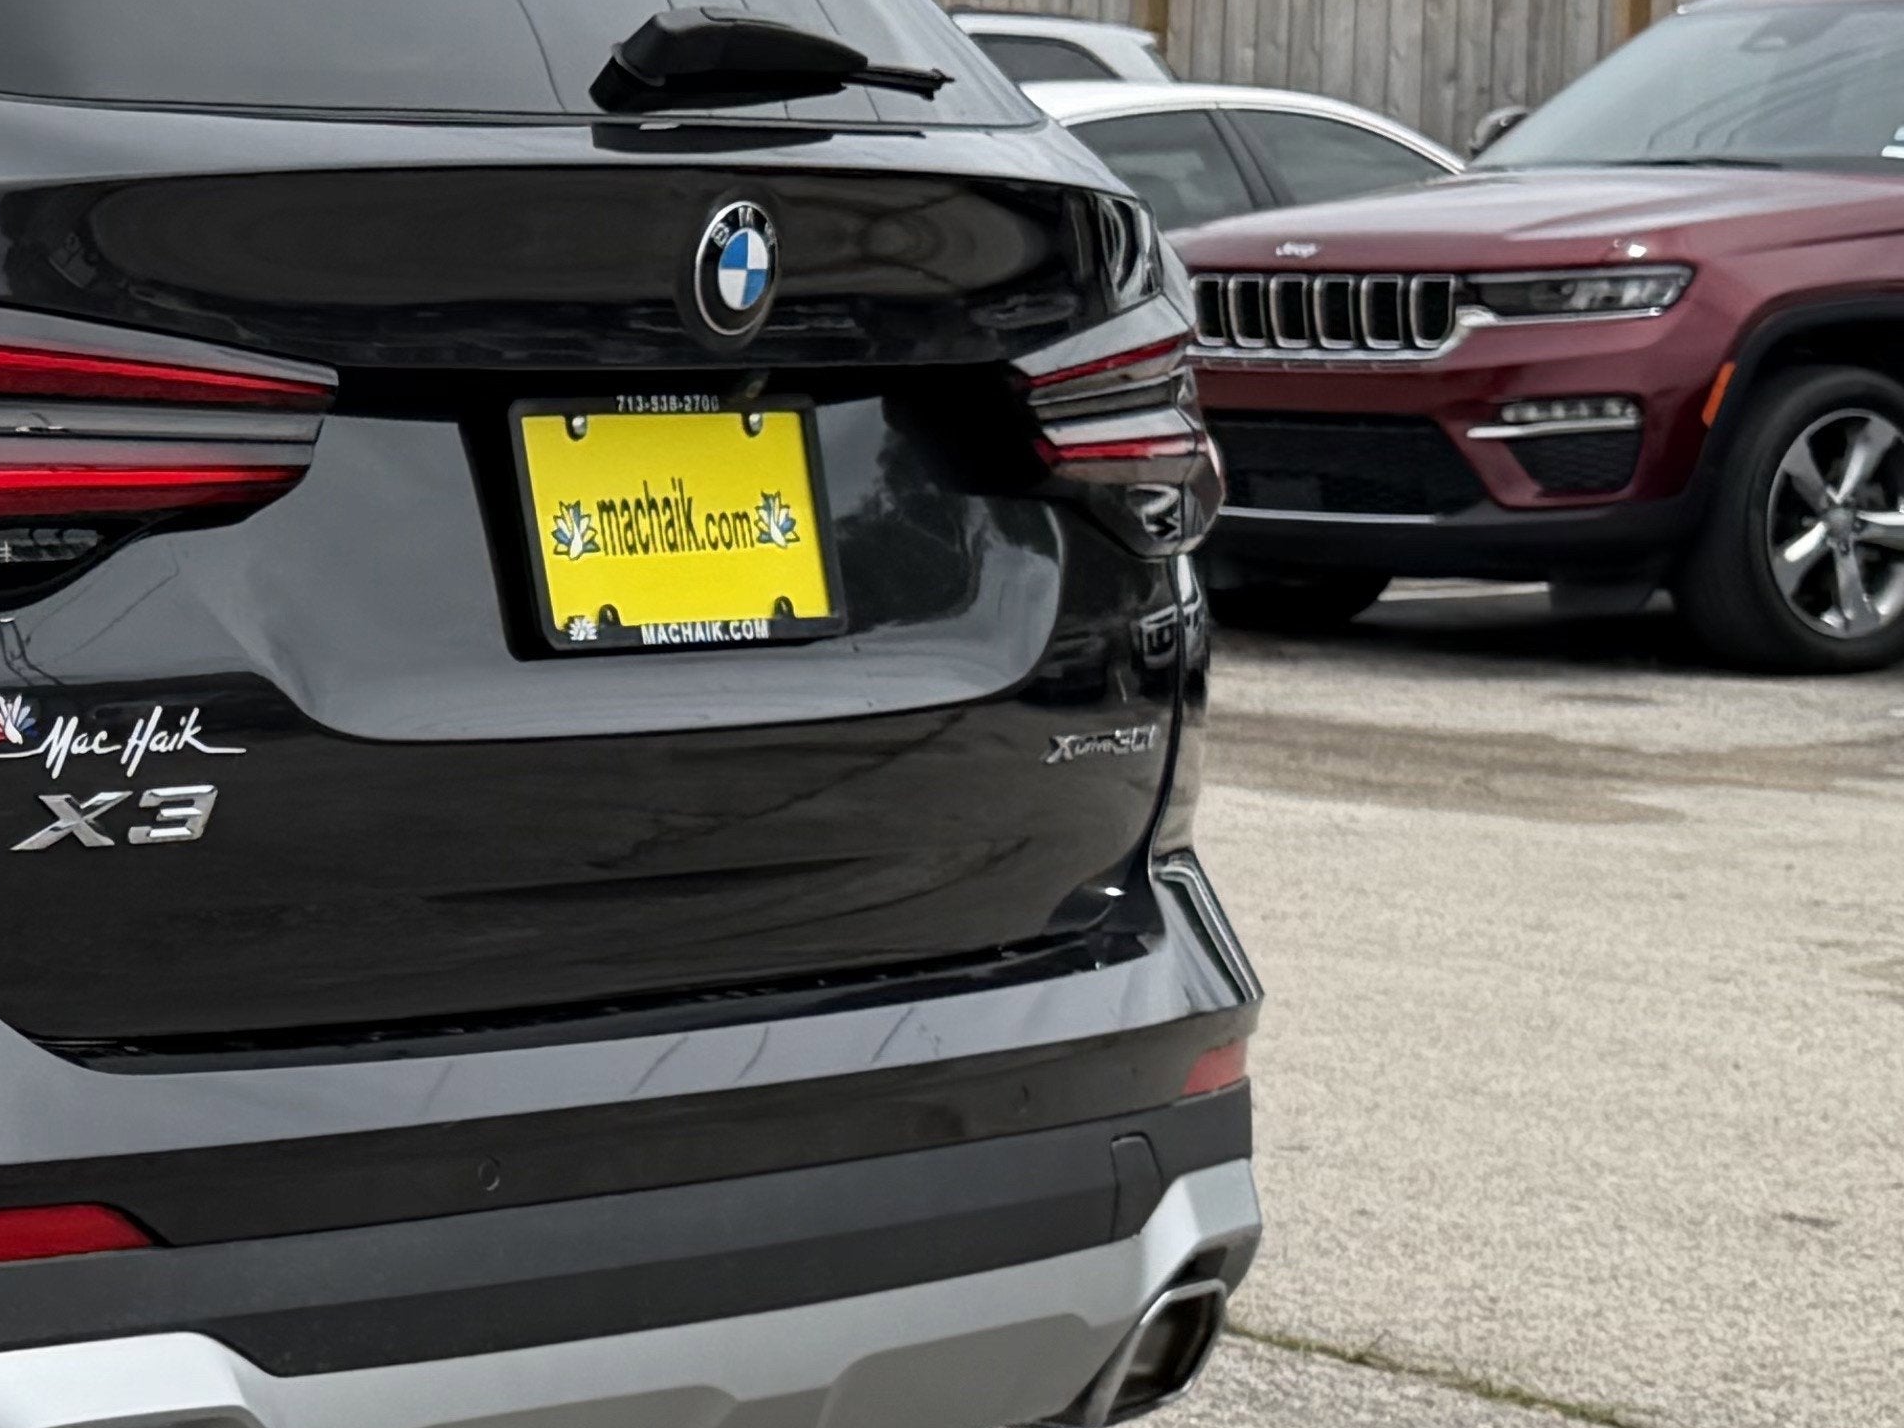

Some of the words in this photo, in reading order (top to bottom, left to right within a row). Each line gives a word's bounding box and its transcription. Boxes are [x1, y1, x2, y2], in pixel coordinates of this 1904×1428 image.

[711, 206, 777, 249] BMW
[596, 475, 756, 557] machaik.com
[640, 618, 770, 646] MACHAIK.COM
[120, 704, 247, 778] Haik
[9, 784, 219, 852] X3
